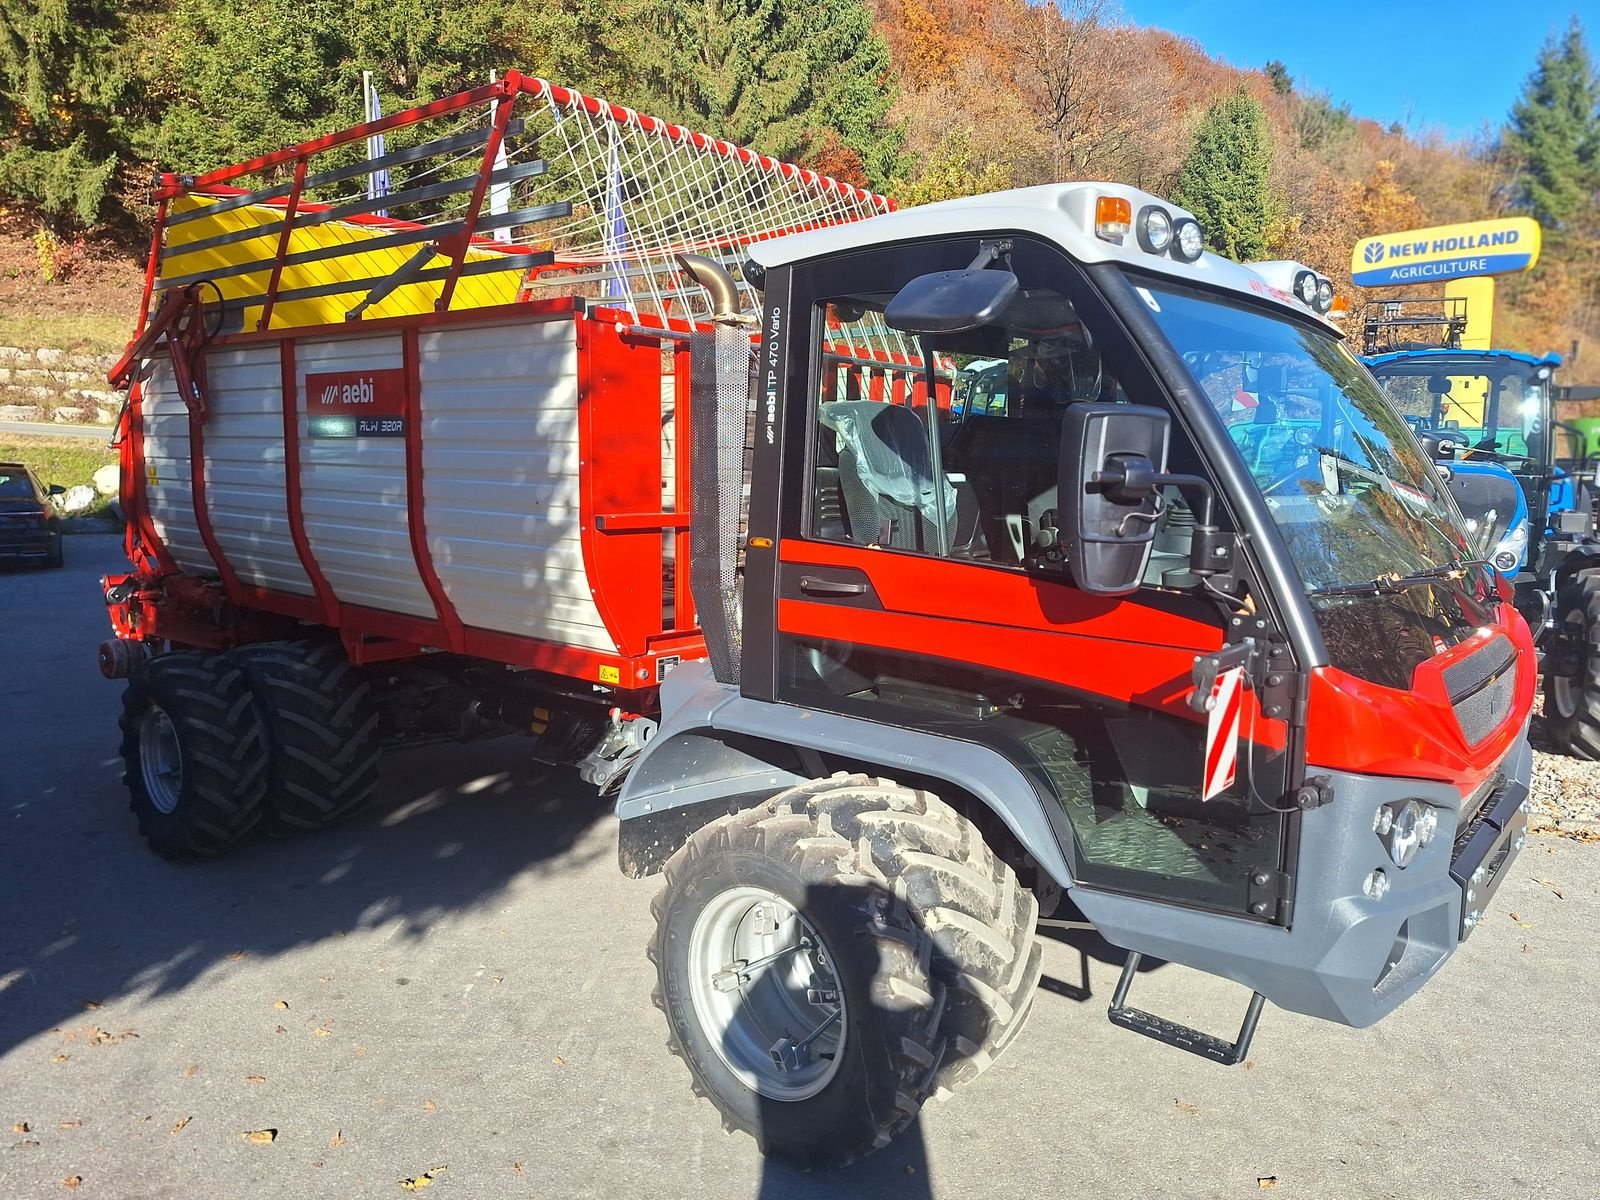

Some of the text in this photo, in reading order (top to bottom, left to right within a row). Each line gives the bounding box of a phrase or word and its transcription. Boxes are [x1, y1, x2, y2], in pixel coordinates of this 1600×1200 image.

[1389, 230, 1519, 258] NEW HOLLAND
[1390, 258, 1487, 279] AGRICULTURE
[766, 307, 781, 422] aebi TP 470 Vario
[342, 378, 374, 404] aebi
